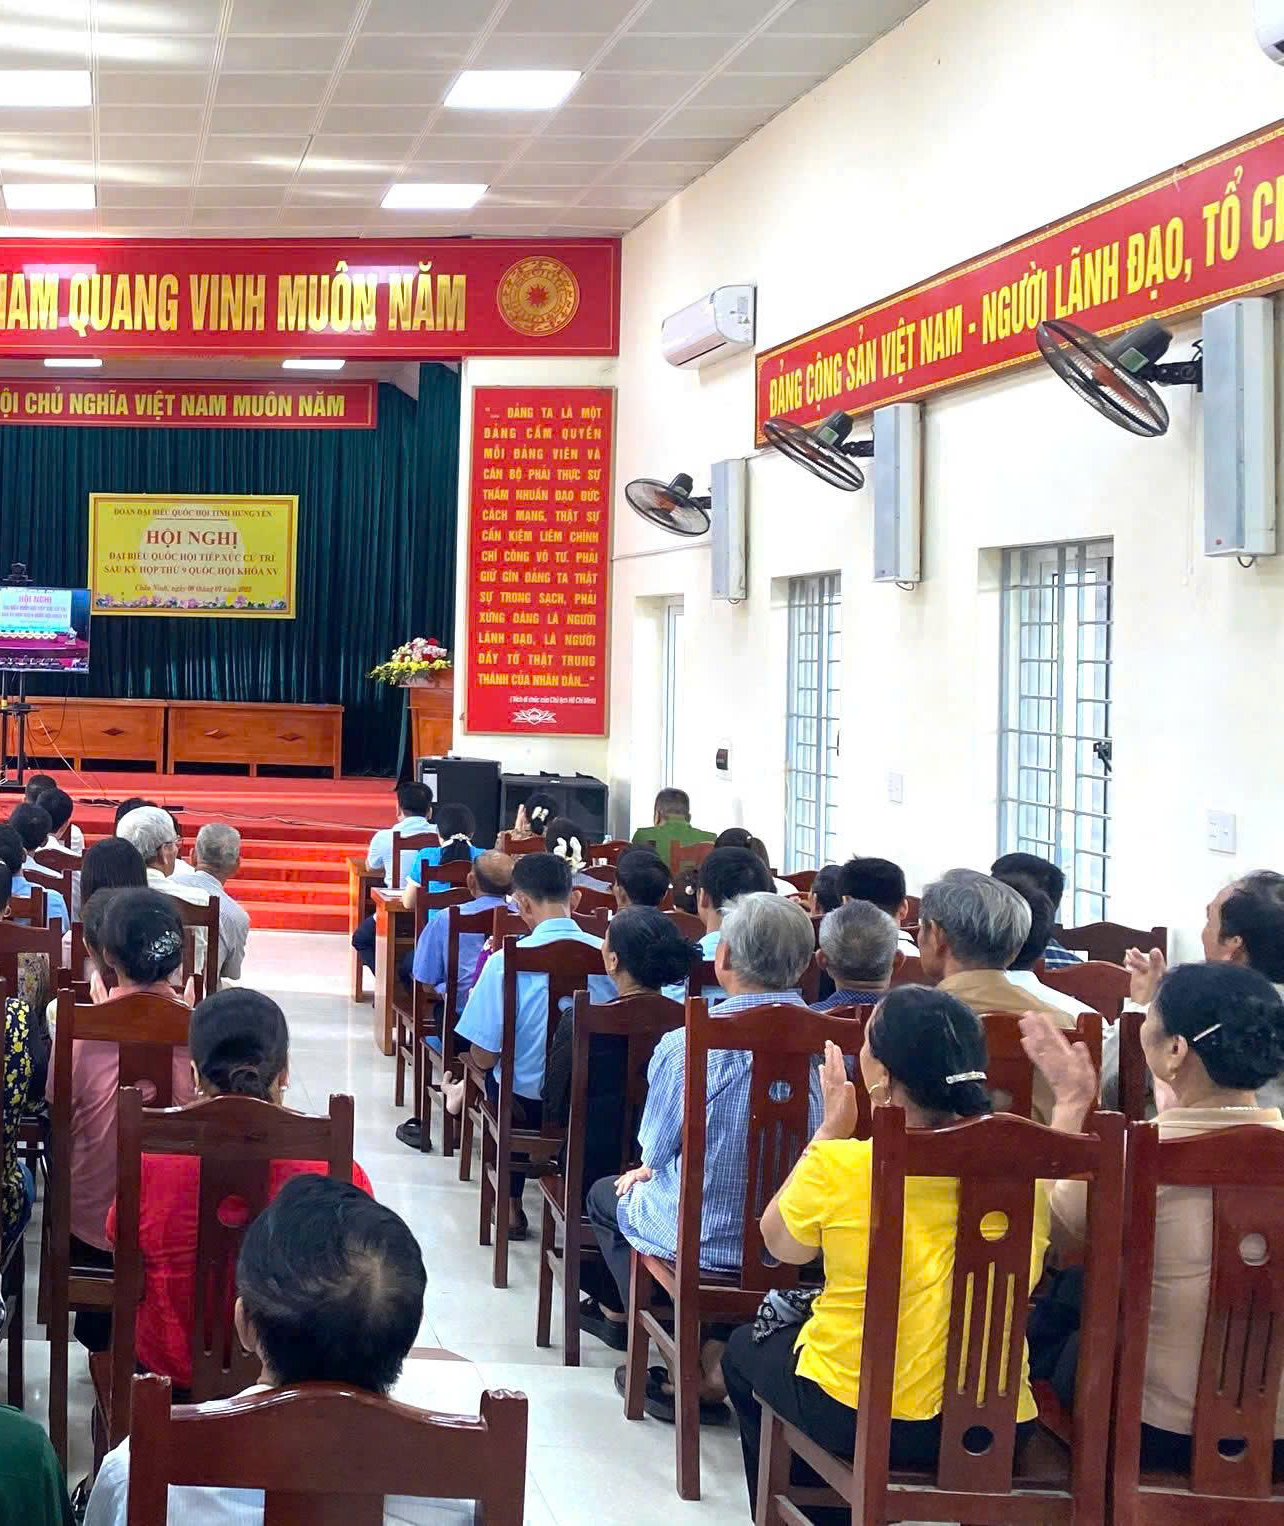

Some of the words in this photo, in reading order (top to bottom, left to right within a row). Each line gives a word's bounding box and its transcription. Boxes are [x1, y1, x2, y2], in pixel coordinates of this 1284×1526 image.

[69, 273, 178, 338] QUANG
[190, 274, 266, 331] VINH
[278, 260, 377, 332] MUÔN
[389, 259, 466, 331] NĂM
[769, 352, 803, 416] ĐẢNG
[805, 351, 843, 408] CỘNG
[846, 325, 877, 385] SẢN
[882, 318, 915, 383] VIỆT
[920, 305, 963, 365] NAM
[982, 261, 1047, 345] NGƯỜI
[1055, 245, 1119, 315] LÃNH
[1126, 217, 1192, 299] ĐẠO,
[1203, 165, 1243, 267] TỔ
[25, 386, 63, 414] CHỦ
[70, 389, 128, 415] NGHĨA
[135, 390, 175, 421] VIỆT
[181, 394, 227, 416] NAM
[233, 391, 294, 417] MUÔN
[298, 391, 345, 417] NĂM
[542, 408, 553, 418] TA
[562, 405, 572, 418] LÀ
[581, 406, 602, 422] MỘT
[553, 447, 578, 460] VIÊN
[588, 447, 600, 460] VÀ
[147, 528, 181, 548] HỘI
[188, 531, 237, 549] NGHỊ
[557, 572, 568, 583] TA
[500, 592, 531, 603] TRONG
[562, 656, 596, 666] TRUNG
